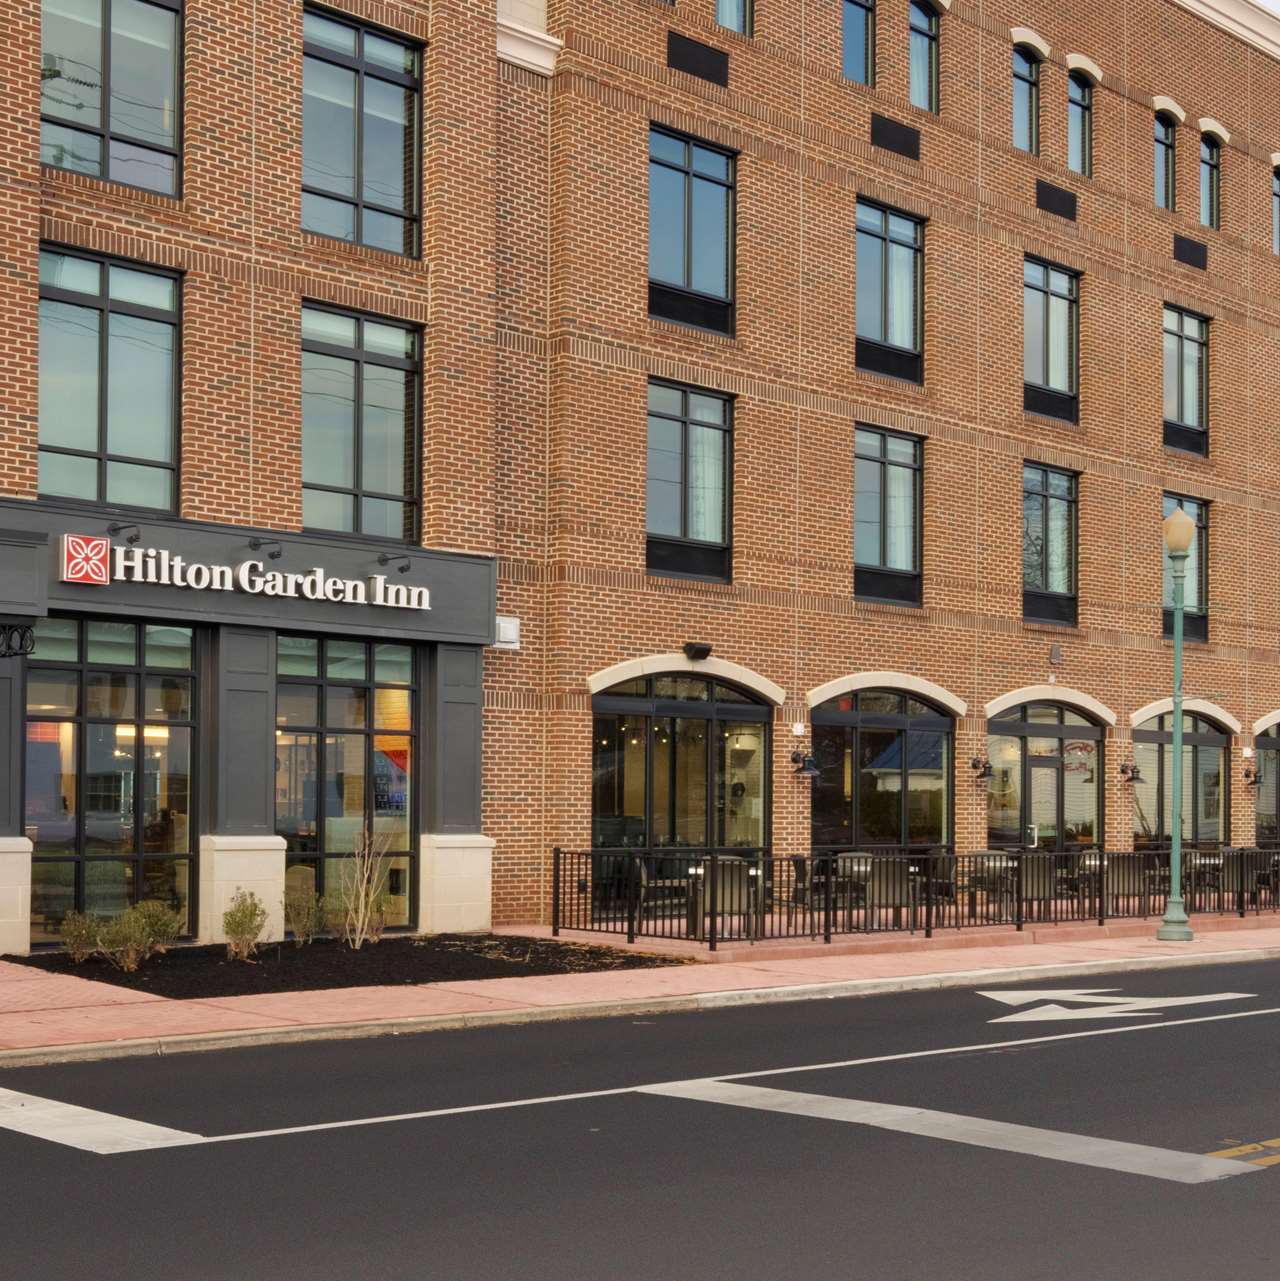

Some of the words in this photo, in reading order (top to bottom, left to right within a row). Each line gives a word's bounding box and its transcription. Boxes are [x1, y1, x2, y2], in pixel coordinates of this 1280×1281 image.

[113, 545, 234, 591] Hilton
[238, 560, 367, 603] Garden
[370, 574, 431, 610] Inn
